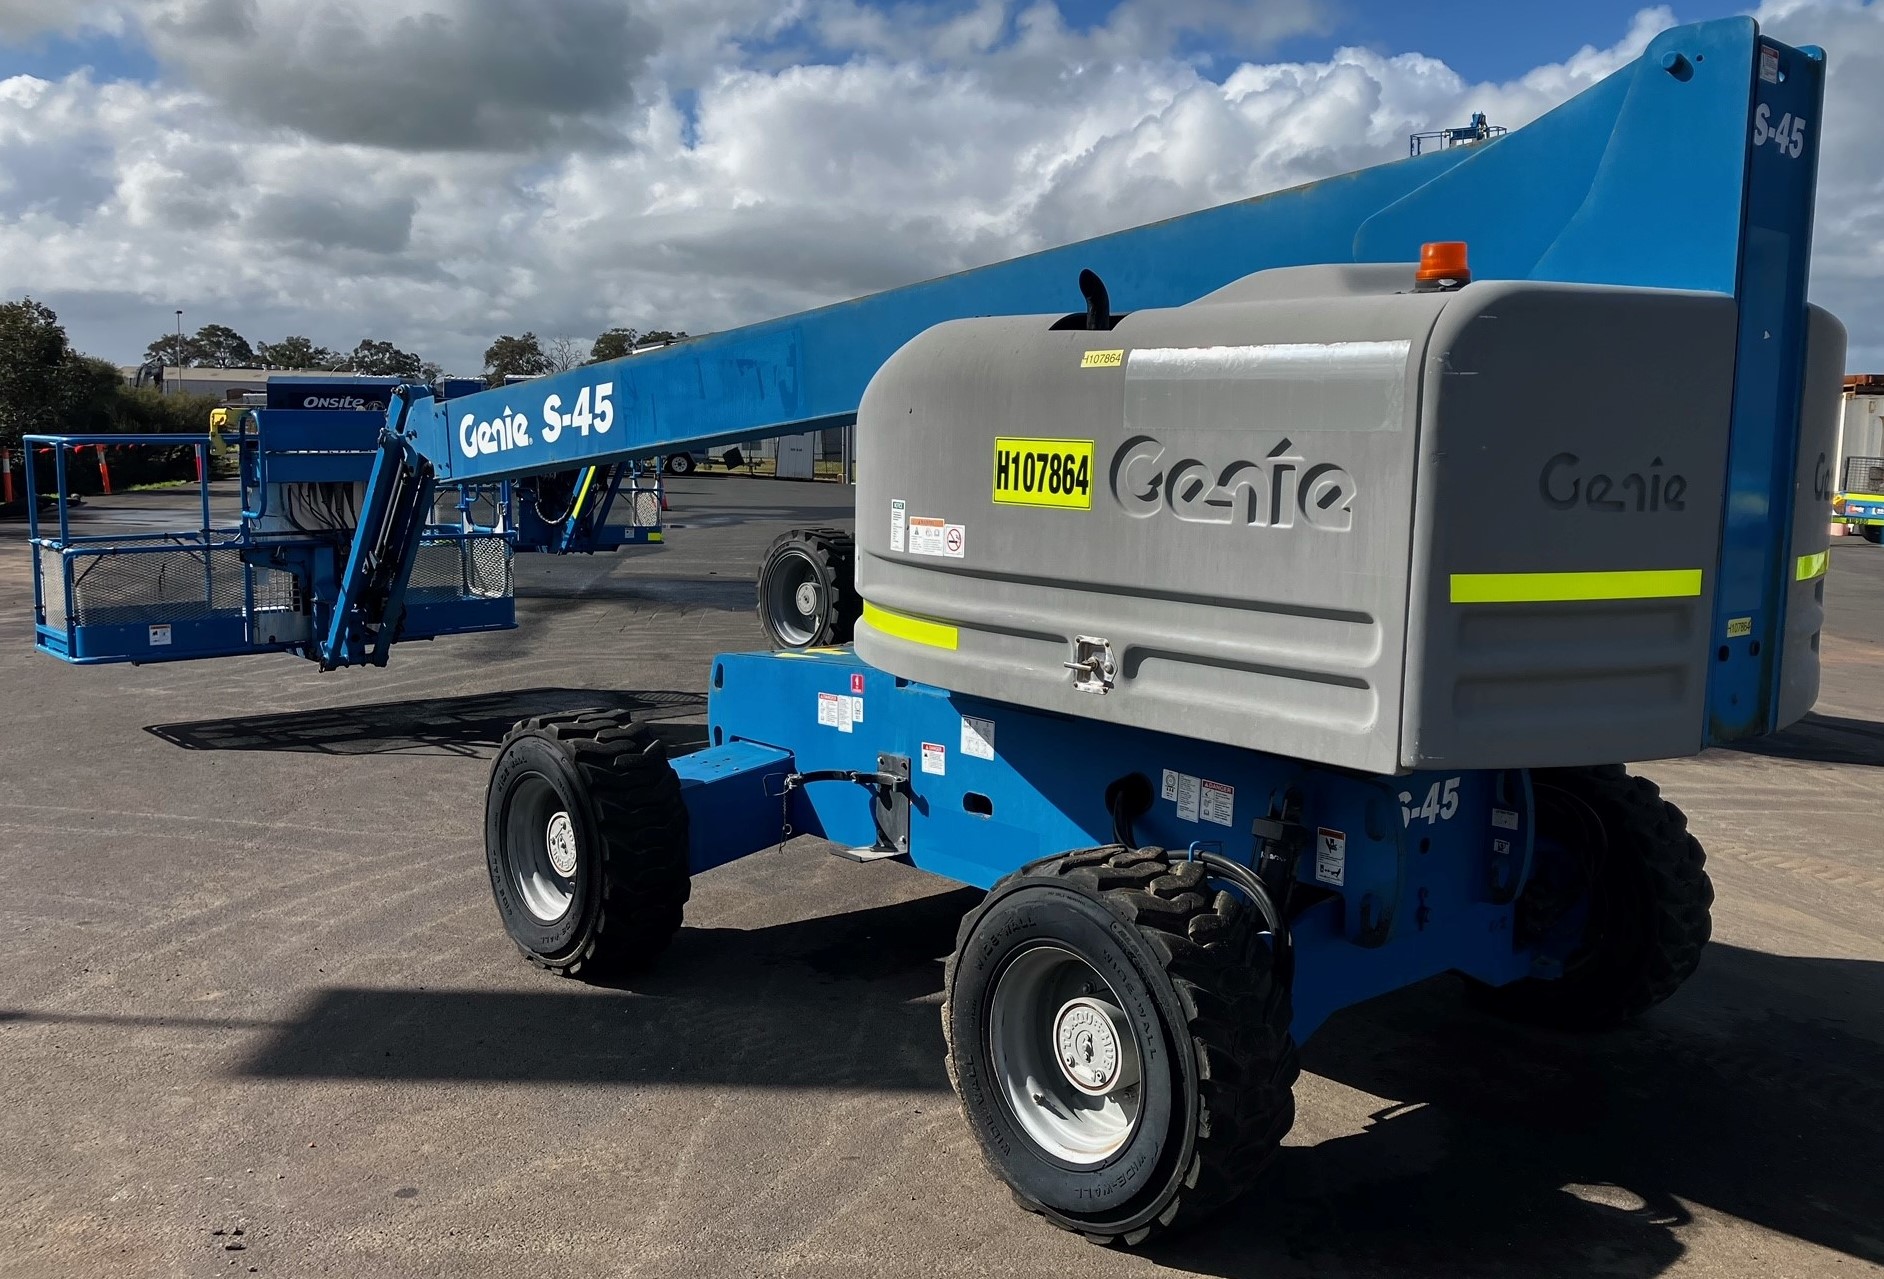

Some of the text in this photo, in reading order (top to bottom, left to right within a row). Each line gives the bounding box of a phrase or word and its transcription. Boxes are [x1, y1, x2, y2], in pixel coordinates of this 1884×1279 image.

[1753, 102, 1807, 159] S-45
[459, 381, 614, 459] Genie S-45
[996, 450, 1089, 496] H107864
[1109, 434, 1358, 533] Genie
[1538, 451, 1688, 512] Genie
[1208, 783, 1232, 793] DANGER
